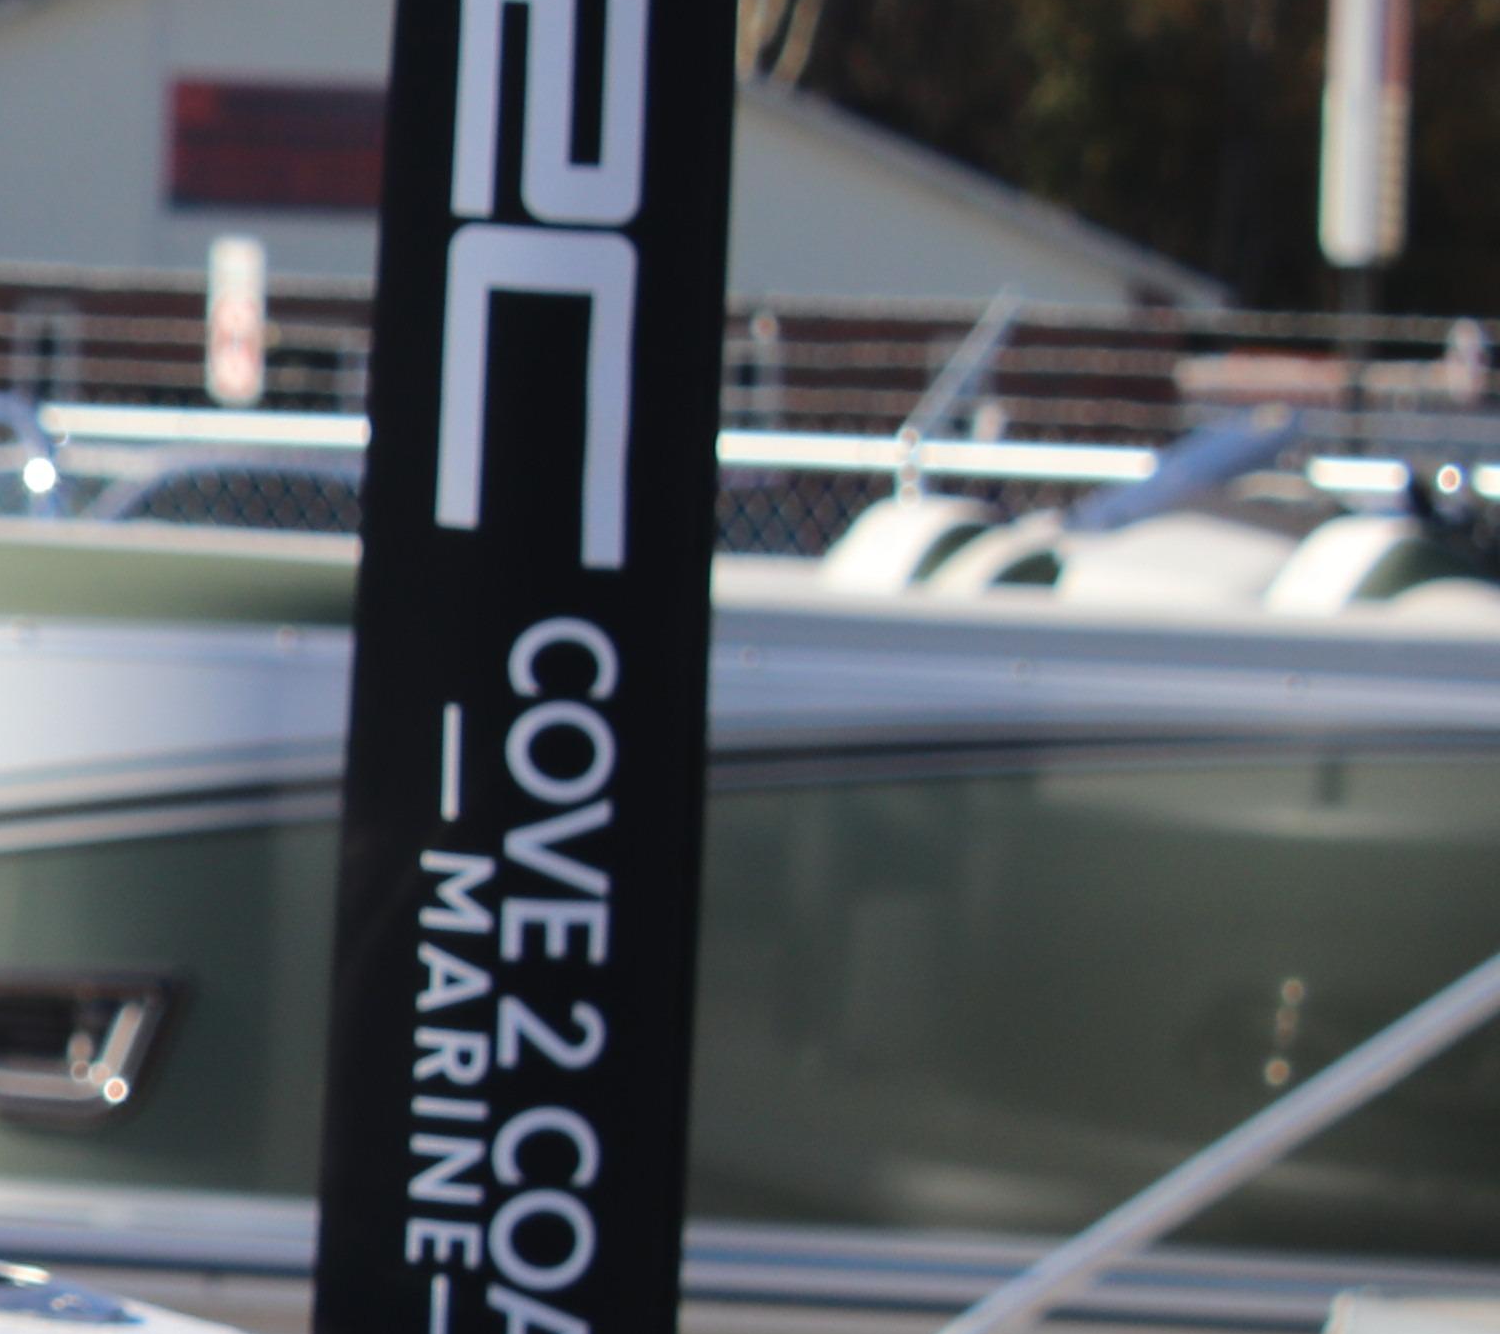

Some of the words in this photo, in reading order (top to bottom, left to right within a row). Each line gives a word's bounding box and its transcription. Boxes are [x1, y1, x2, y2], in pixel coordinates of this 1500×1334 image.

[502, 616, 620, 964] COVE
[405, 849, 496, 1270] MARINE
[497, 995, 607, 1069] 2
